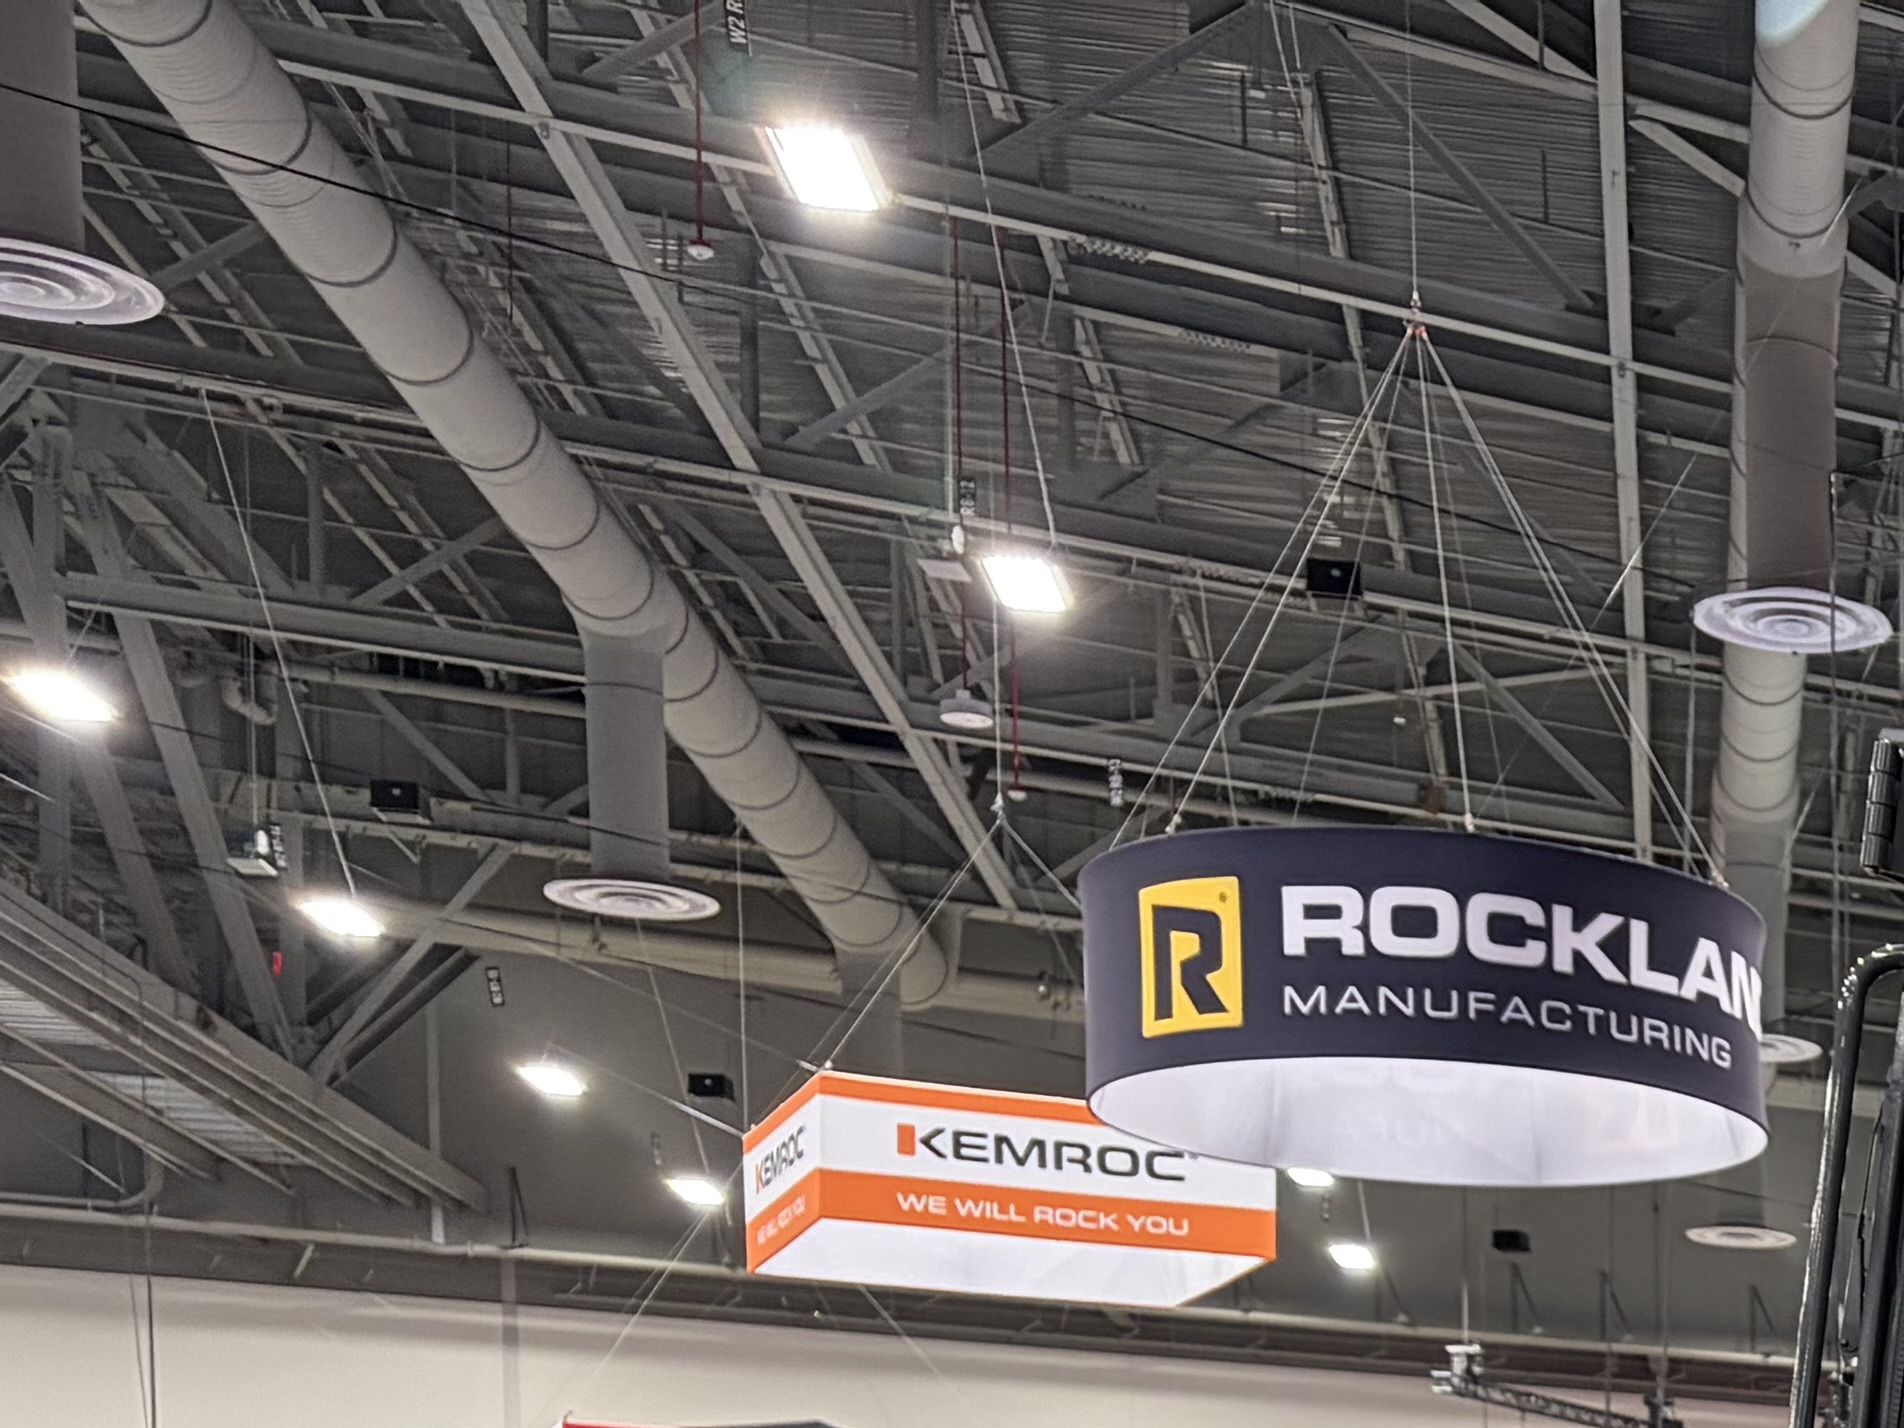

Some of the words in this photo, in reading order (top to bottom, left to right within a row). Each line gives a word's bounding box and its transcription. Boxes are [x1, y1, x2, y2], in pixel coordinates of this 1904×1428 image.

[728, 15, 747, 44] W2
[1281, 884, 1763, 1041] ROCKLAN
[1283, 985, 1733, 1070] MANUFACTURING
[897, 1121, 1187, 1183] KEMROC
[896, 1192, 947, 1216] WE
[954, 1198, 1027, 1224] WILL
[1034, 1206, 1121, 1232] ROCK
[1126, 1214, 1190, 1237] YOU
